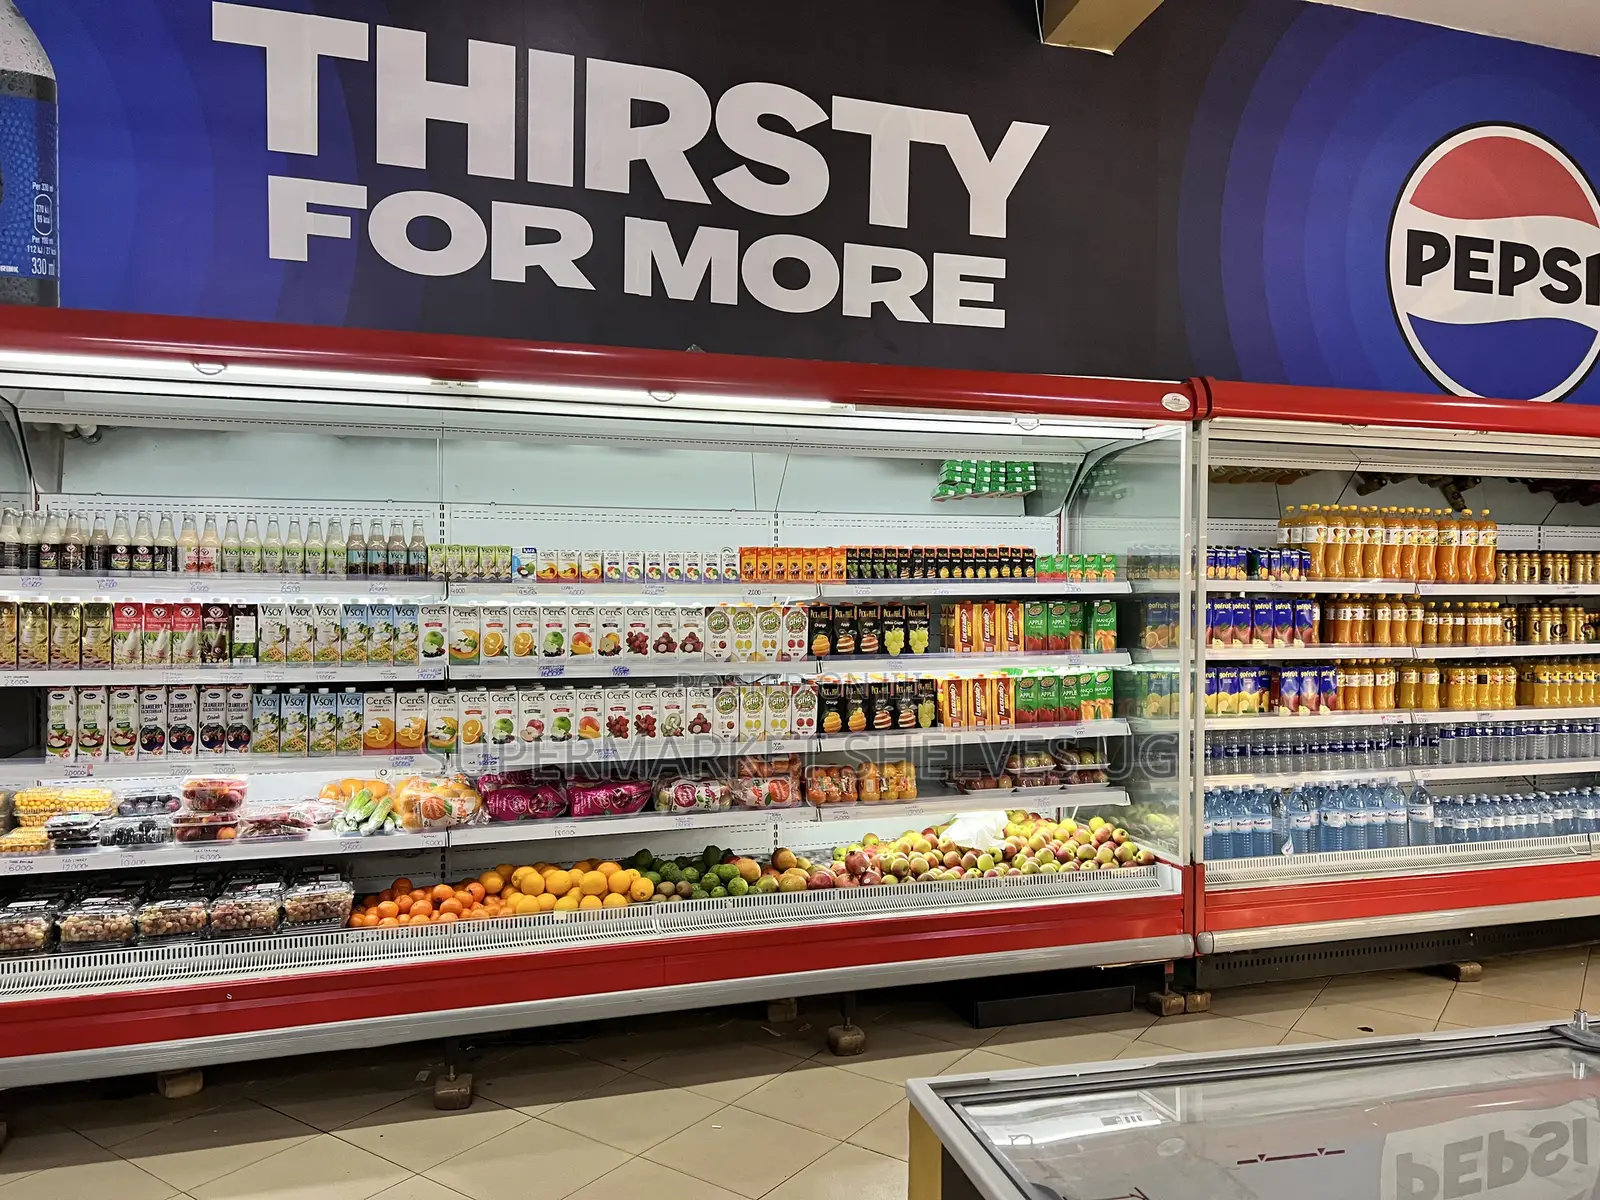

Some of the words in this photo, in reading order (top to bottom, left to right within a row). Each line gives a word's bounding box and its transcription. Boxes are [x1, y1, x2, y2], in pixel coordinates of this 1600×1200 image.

[212, 1, 1049, 238] THIRSTY
[27, 245, 36, 253] 112
[268, 176, 595, 290] FOR
[625, 216, 1006, 328] MORE
[31, 257, 47, 275] 330
[48, 259, 55, 276] ml
[1406, 229, 1600, 308] PEPSI
[281, 585, 300, 593] 6500
[421, 606, 447, 615] Ceres
[1148, 602, 1167, 610] gofrut
[452, 608, 478, 617] Ceres
[482, 607, 508, 616] Ceres
[512, 607, 538, 616] Ceres
[542, 607, 567, 616] Ceres
[571, 607, 595, 616] Ceres
[599, 607, 623, 616] Ceres
[626, 607, 650, 616] Ceres
[654, 607, 677, 616] Ceres
[680, 607, 703, 616] Ceres
[983, 611, 991, 642] Lucozade
[1096, 618, 1115, 626] MANGO
[1219, 671, 1237, 679] gofrut
[1240, 670, 1257, 678] gofrut
[1282, 670, 1298, 678] gofrut
[1301, 670, 1318, 678] gofrut
[607, 691, 630, 699] Ceres
[634, 690, 658, 698] Ceres
[1095, 686, 1112, 695] MANGO
[366, 696, 392, 705] Ceres
[399, 696, 425, 705] Ceres
[431, 696, 456, 705] Ceres
[461, 694, 487, 703] Ceres
[491, 694, 516, 703] Ceres
[521, 694, 545, 703] Ceres
[549, 693, 574, 701] Ceres
[578, 692, 602, 700] Ceres
